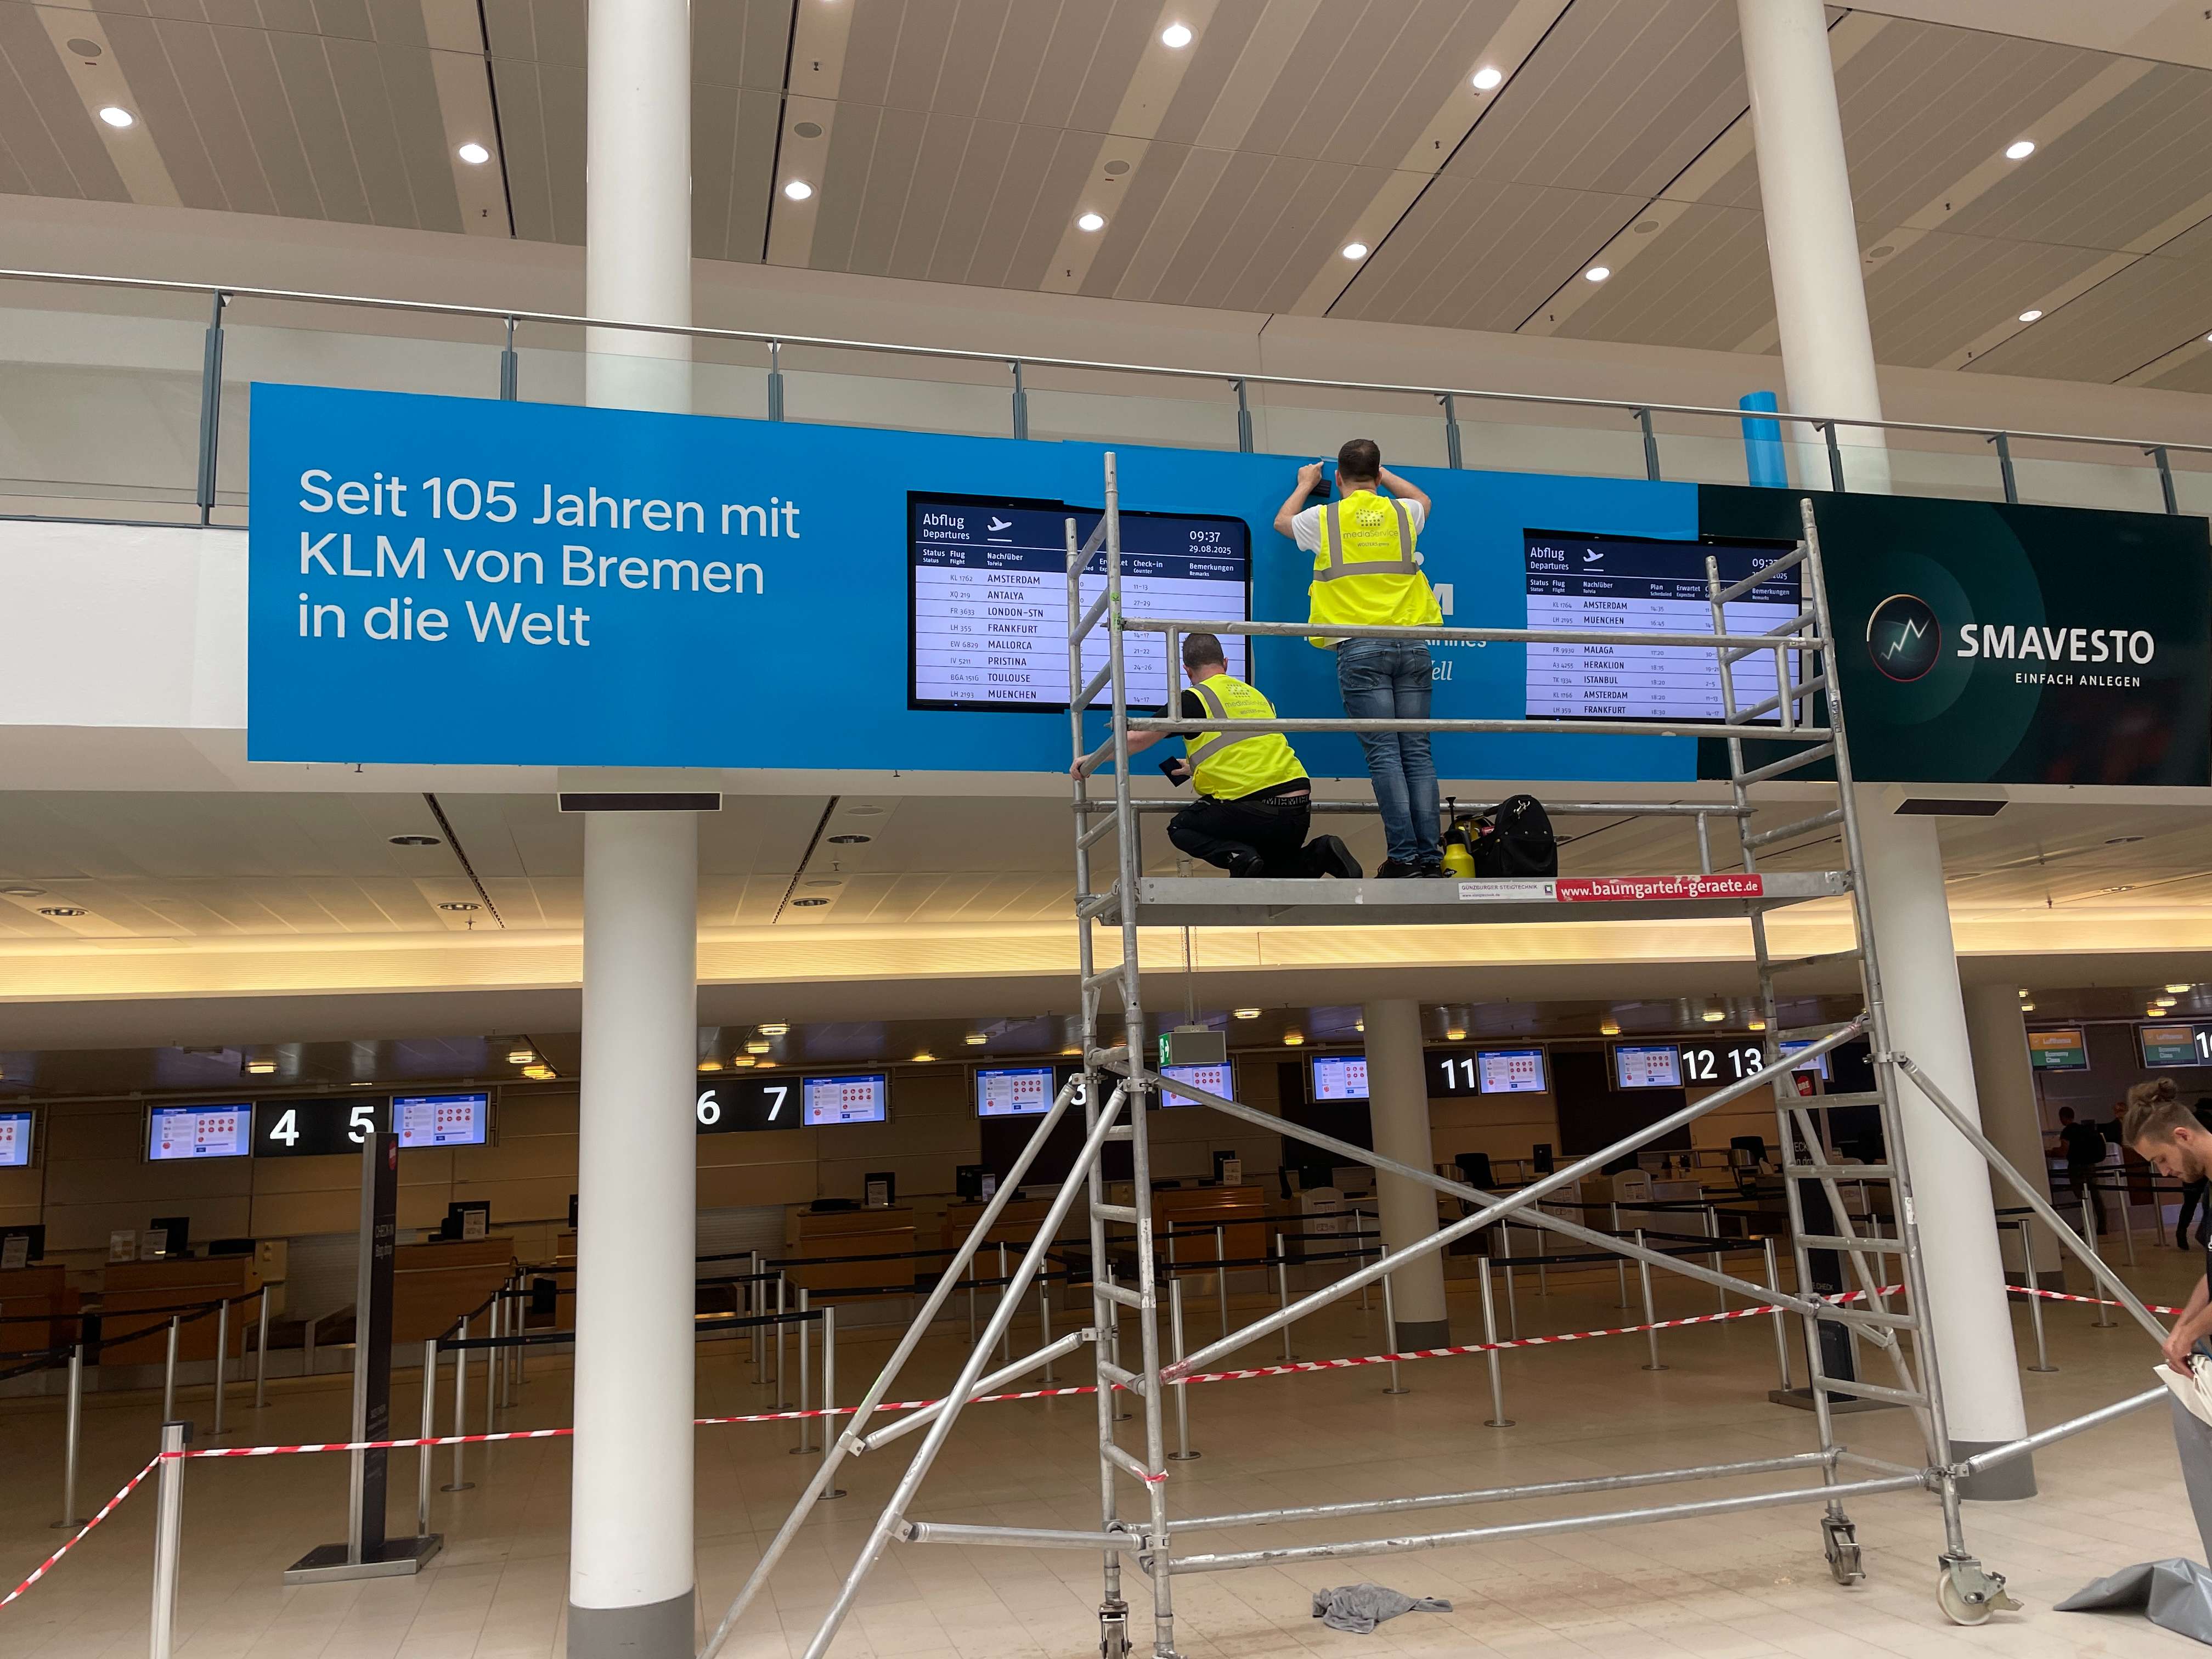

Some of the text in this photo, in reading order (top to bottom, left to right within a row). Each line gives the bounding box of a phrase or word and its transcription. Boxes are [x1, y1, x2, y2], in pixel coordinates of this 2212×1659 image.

[298, 469, 800, 539] Seit 105 Jahren mit
[923, 514, 964, 529] Abflug
[923, 529, 970, 540] Departures
[1189, 531, 1221, 543] 09:37
[1343, 529, 1398, 539] mediaService
[1189, 545, 1231, 555] 29.08.2025
[1531, 547, 1564, 561] Abflug
[301, 531, 764, 595] KLM von Bremen
[950, 550, 965, 558] Flug
[987, 552, 1023, 561] Nach/über
[1133, 560, 1163, 568] Check-in
[1189, 563, 1234, 572] Bemerkungen
[1531, 561, 1569, 571] Departures
[988, 575, 1040, 584] AMSTERDAM
[988, 591, 1024, 600] ANTALYA
[1583, 601, 1627, 610] AMSTERDAM
[988, 607, 1043, 617] LONDON-STN
[299, 592, 591, 647] in die Welt
[1584, 616, 1624, 624] MUENCHEN
[988, 624, 1037, 634] FRANKFURT
[988, 641, 1032, 650] MALLORCA
[1957, 624, 2154, 664] SMAVESTO
[988, 657, 1026, 666] PRISTINA
[1431, 660, 1453, 681] ell
[988, 673, 1030, 682] TOULOUSE
[1584, 676, 1618, 684] ISTANBUL
[2016, 673, 2140, 687] EINFACH ANLEGEN
[988, 690, 1036, 699] MUENCHEN
[1584, 691, 1628, 699] AMSTERDAM
[1584, 706, 1626, 714] FRANKFURT
[1561, 879, 1758, 900] www.baumgarten-geraete.de
[1682, 1048, 1763, 1080] 12 13
[1441, 1058, 1476, 1089] 11
[696, 1087, 788, 1125] 6 7
[269, 1106, 375, 1147] 4 5
